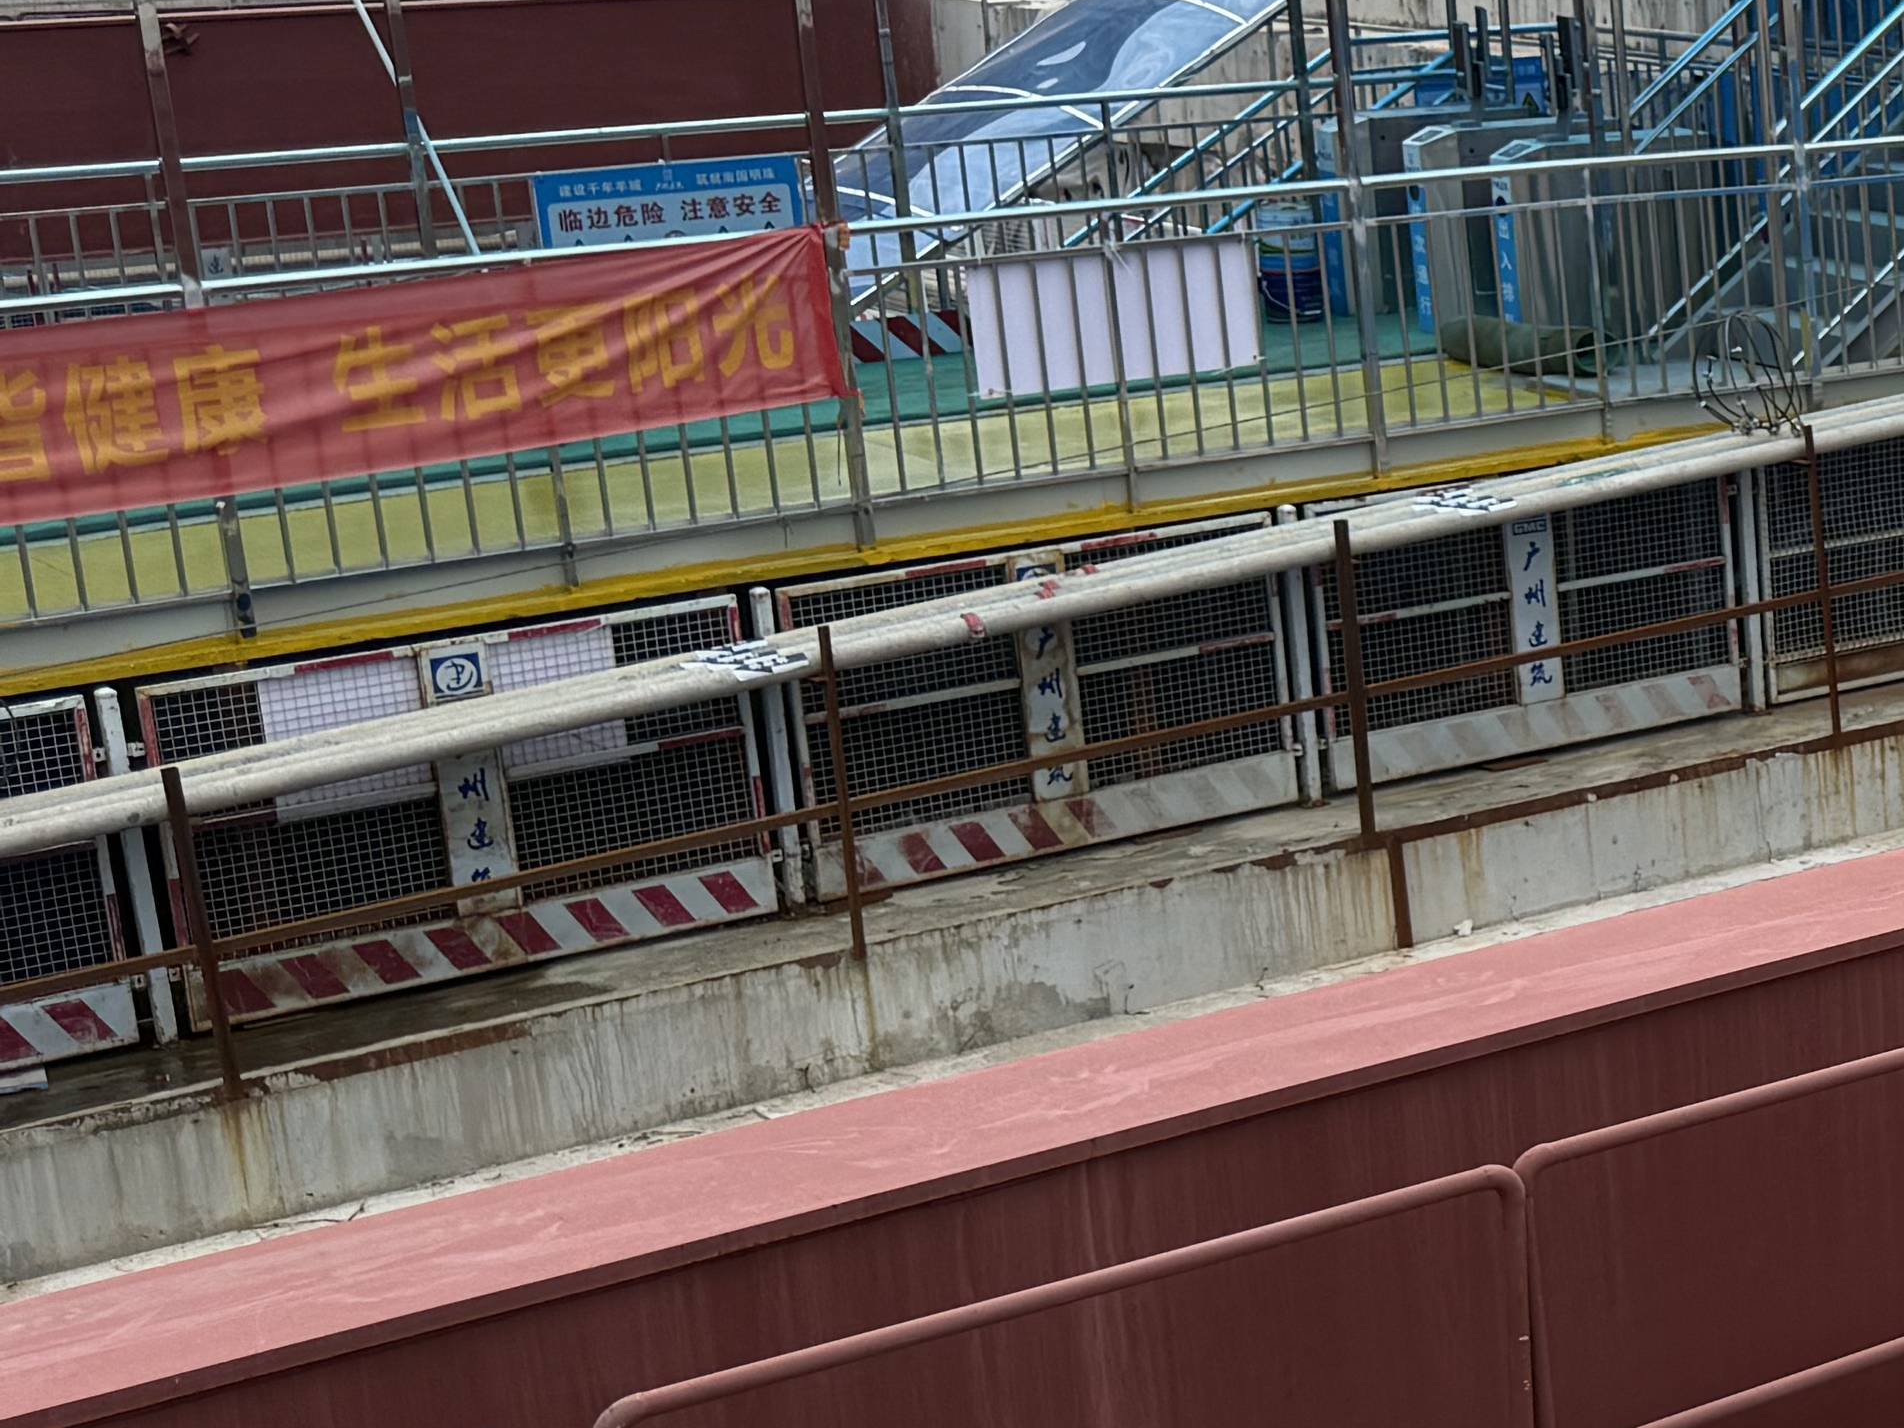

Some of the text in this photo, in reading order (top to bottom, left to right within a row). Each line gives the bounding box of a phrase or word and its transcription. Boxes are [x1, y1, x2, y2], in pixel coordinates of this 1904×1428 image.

[558, 190, 783, 234] 临边危险 注意安全
[331, 274, 797, 434] 生活更阳光
[1523, 541, 1553, 688] 广州建筑
